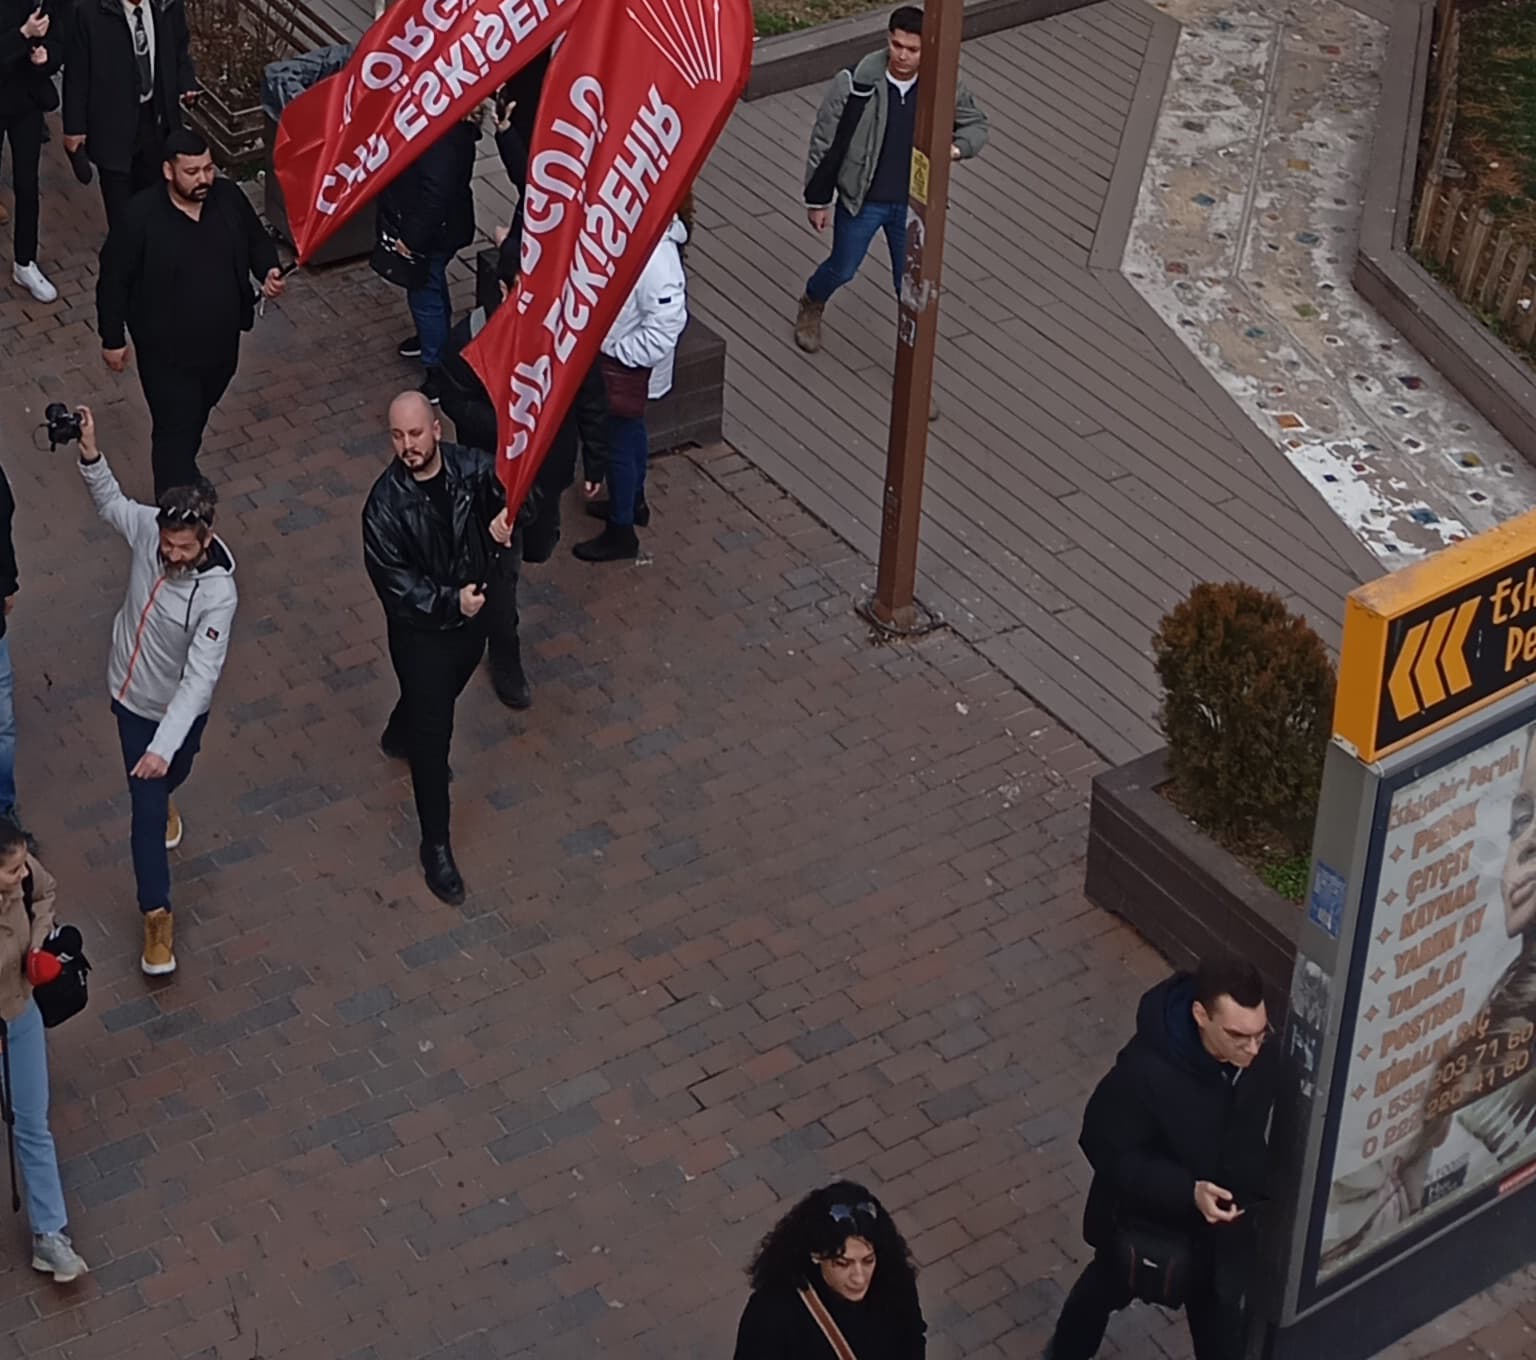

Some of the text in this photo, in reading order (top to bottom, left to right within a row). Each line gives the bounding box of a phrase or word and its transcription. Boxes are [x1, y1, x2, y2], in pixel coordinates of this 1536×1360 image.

[1398, 875, 1481, 941] KAYNAK
[1365, 1108, 1383, 1131] 0
[1474, 1038, 1501, 1063] 71
[1361, 1135, 1378, 1161] 0
